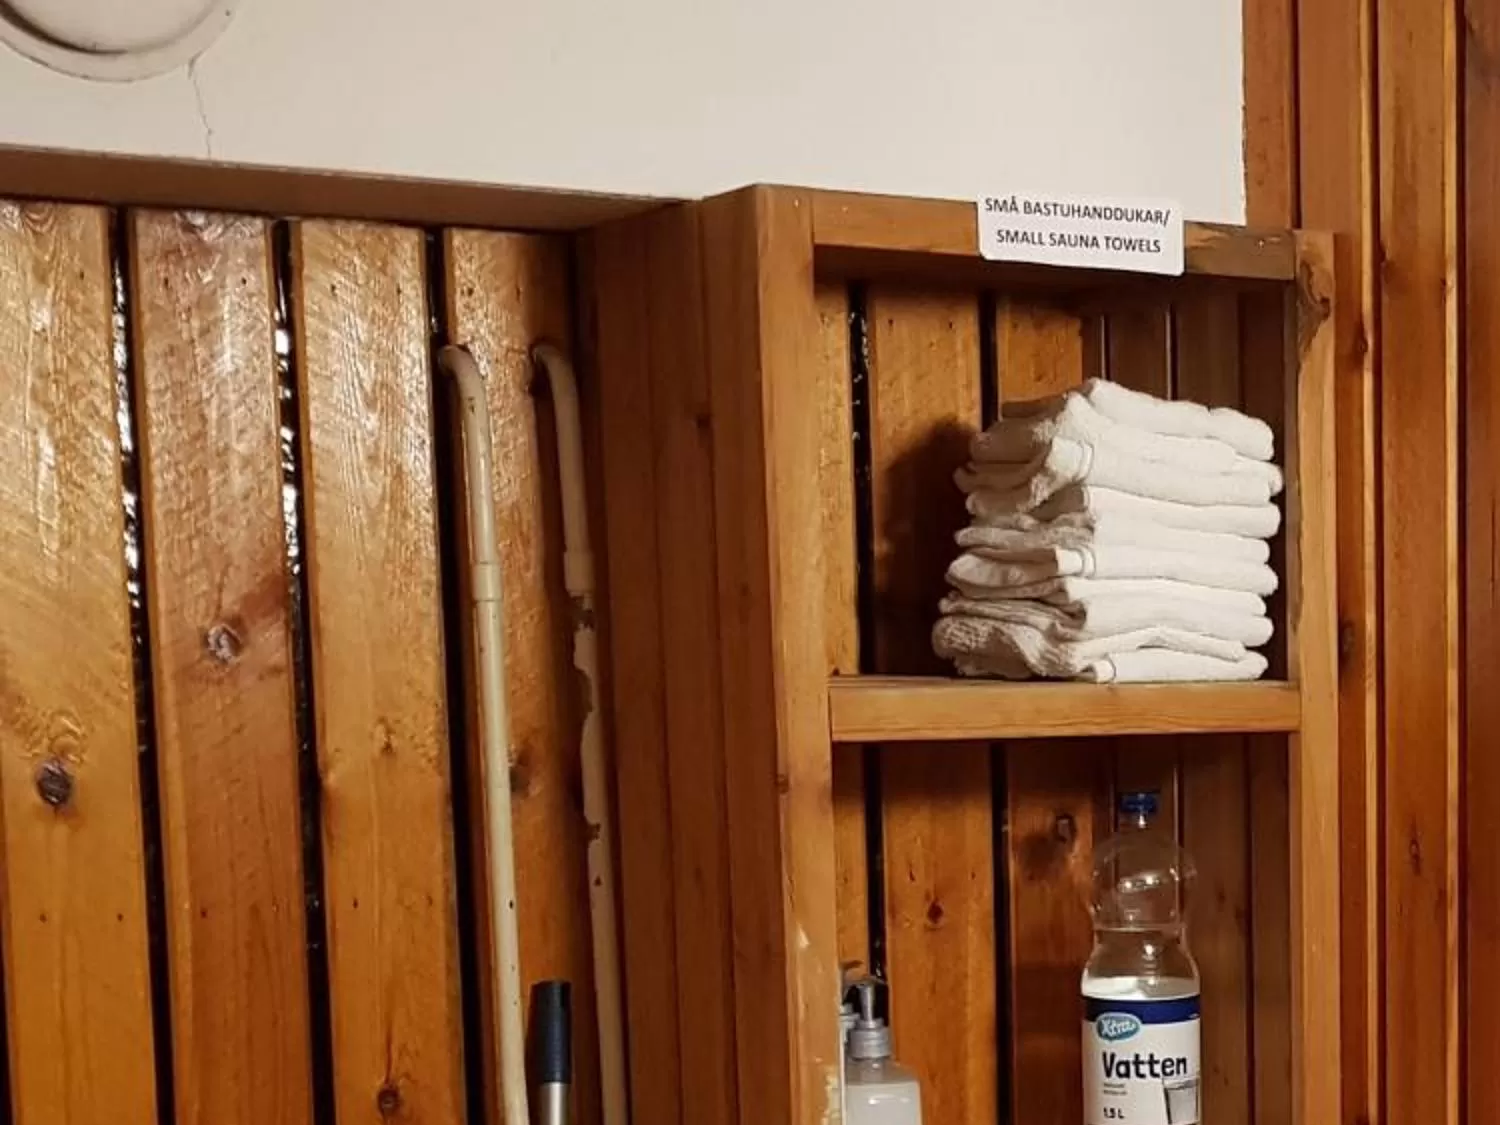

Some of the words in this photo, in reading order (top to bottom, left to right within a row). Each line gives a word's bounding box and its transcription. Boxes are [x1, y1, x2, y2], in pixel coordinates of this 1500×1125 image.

[985, 196, 1019, 213] SMÅ
[1023, 201, 1170, 227] BASTUHANDDUKAR/
[996, 229, 1044, 246] SMALL
[1049, 233, 1100, 249] SAUNA
[1104, 236, 1161, 253] TOWELS
[1102, 1051, 1187, 1079] Vatten
